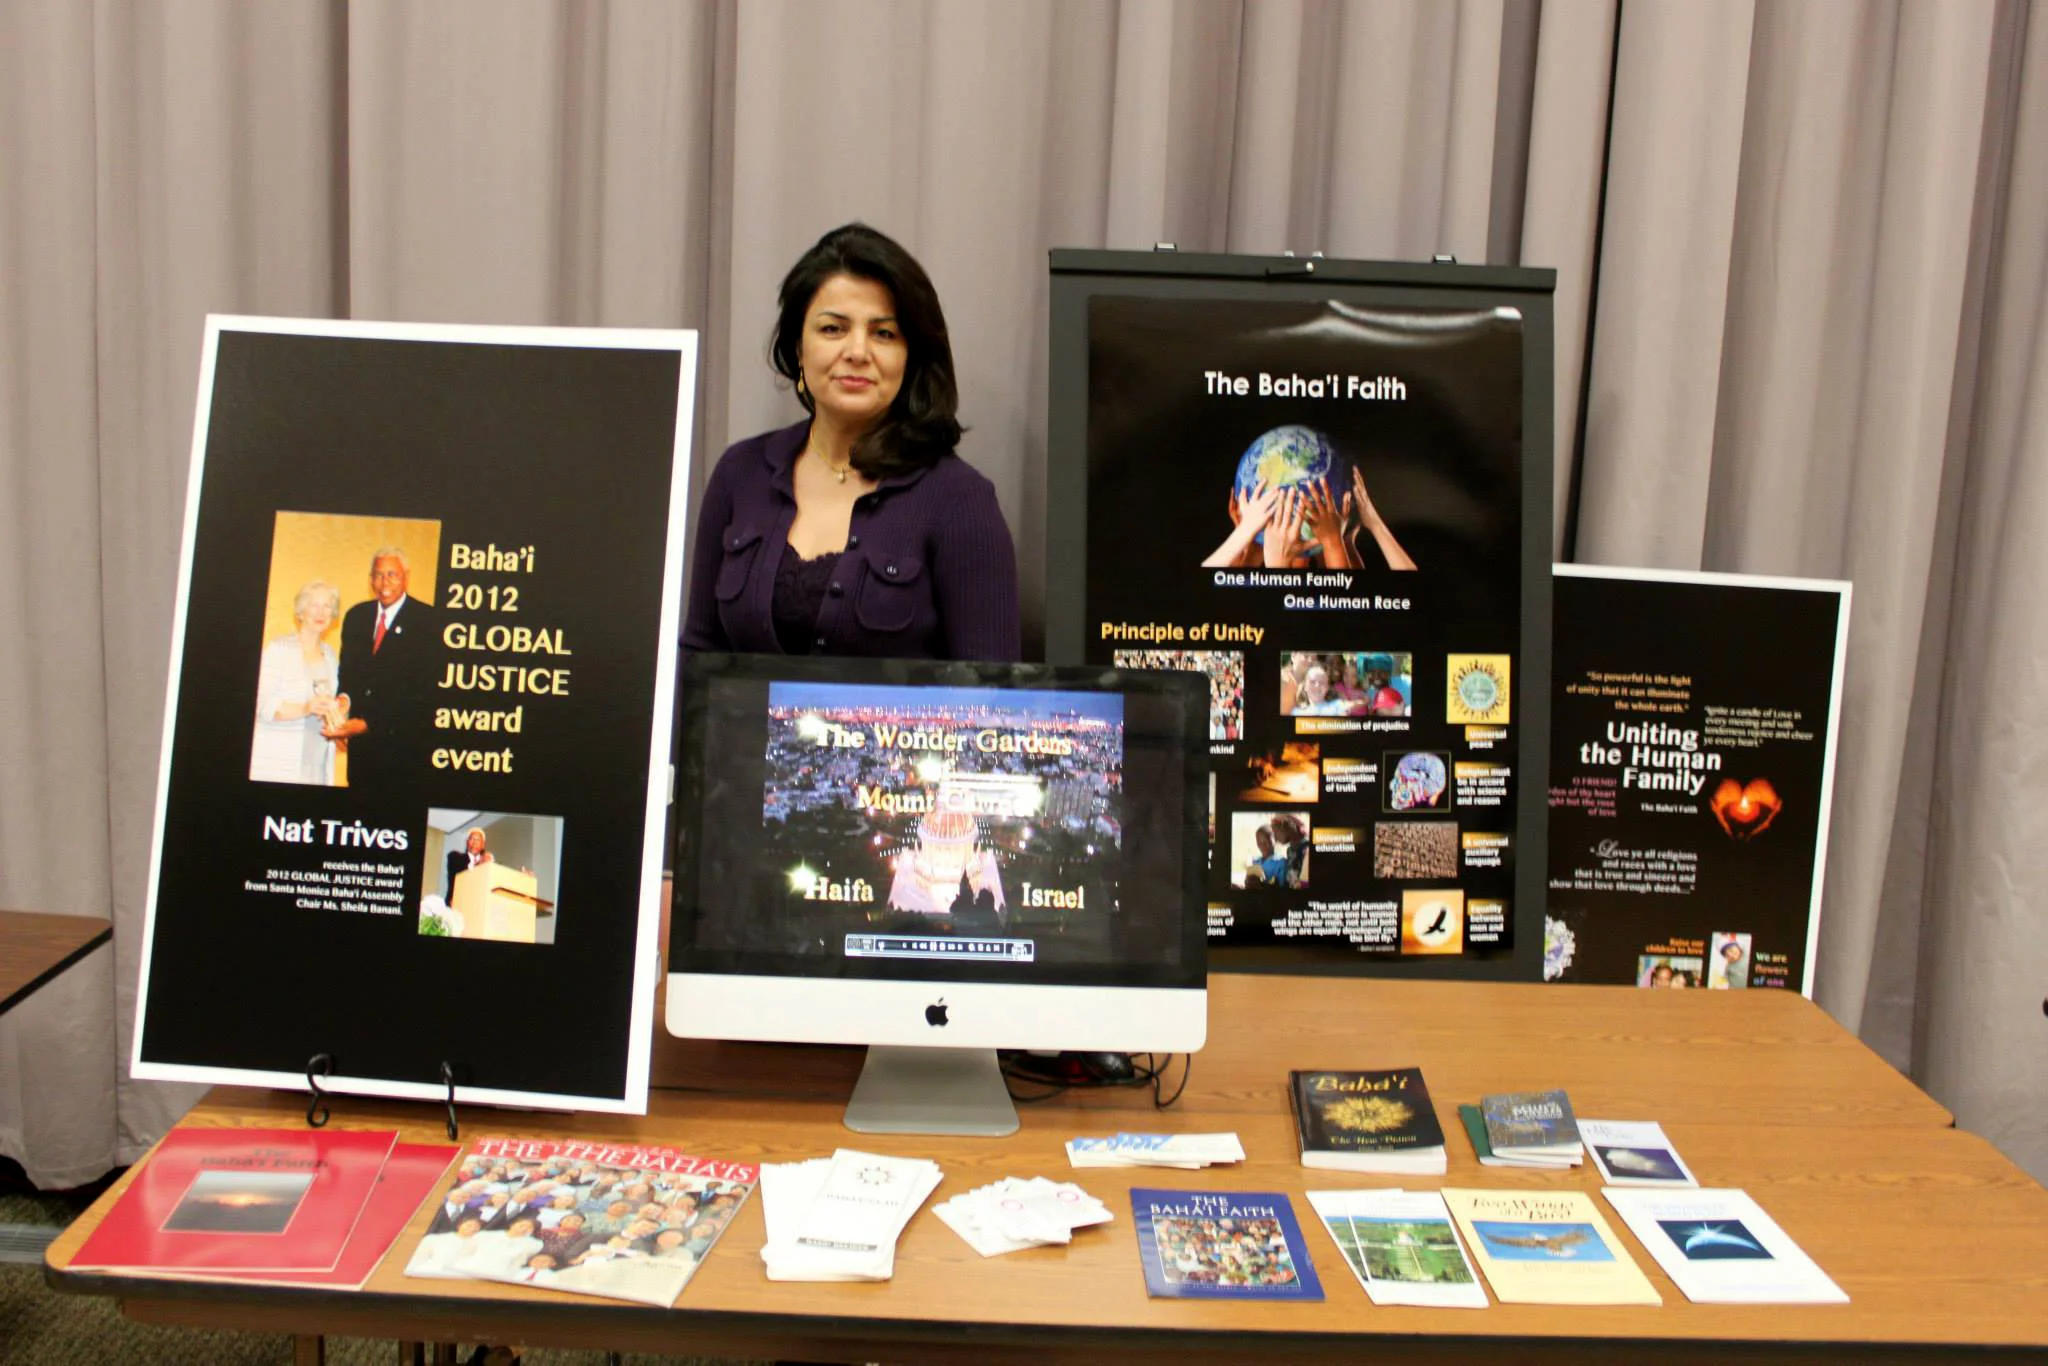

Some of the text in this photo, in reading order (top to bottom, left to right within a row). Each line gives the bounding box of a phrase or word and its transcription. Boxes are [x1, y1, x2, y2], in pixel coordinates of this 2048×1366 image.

[1205, 371, 1406, 400] The Baha'i Faith
[451, 543, 535, 572] Baha'i
[1214, 571, 1353, 590] One Human Family
[446, 584, 519, 612] 2012
[1284, 594, 1411, 610] One Human Race
[443, 623, 572, 655] GLOBAL
[1101, 622, 1265, 646] Principle of Unity
[438, 663, 570, 695] JUSTICE
[1604, 672, 1644, 683] powerful
[1654, 674, 1668, 685] the
[1566, 683, 1577, 693] of
[1577, 684, 1600, 696] unity
[1602, 686, 1619, 696] that
[1630, 688, 1645, 697] can
[1615, 700, 1657, 711] the whole
[435, 706, 522, 733] award
[1363, 720, 1372, 731] of
[1373, 721, 1409, 732] prejudice
[815, 724, 1072, 756] The Wonder Gardens
[1607, 721, 1699, 751] Uniting
[431, 748, 513, 774] event
[1580, 742, 1722, 771] the Human
[1325, 783, 1356, 792] of truth
[1623, 767, 1706, 796] Family
[858, 784, 937, 813] Mount
[1594, 788, 1616, 798] heart
[1640, 802, 1654, 812] The
[1679, 805, 1698, 814] Faith
[263, 815, 408, 850] Nat Trives
[1644, 849, 1656, 859] all
[1657, 850, 1698, 862] religions
[323, 861, 359, 872] receives
[361, 862, 376, 873] the
[1602, 859, 1696, 872] and races with love
[266, 869, 403, 889] 2012 GLOBAL JUSTICE award
[1549, 878, 1573, 889] show
[1574, 879, 1592, 889] that
[1594, 880, 1614, 890] love
[1616, 881, 1651, 893] through
[1575, 869, 1696, 883] that is true and sincere and
[245, 880, 268, 892] from
[269, 883, 295, 894] Santa
[297, 885, 330, 897] Monica
[361, 890, 404, 903] Assembly
[804, 876, 1085, 909] Haifa Israel
[296, 898, 321, 909] Chair
[341, 902, 368, 913] Sheila
[1756, 952, 1770, 962] We
[482, 1141, 543, 1158] THE
[565, 1143, 626, 1164] THE
[1191, 1195, 1229, 1207] THE
[1220, 1205, 1275, 1217] FAITH
